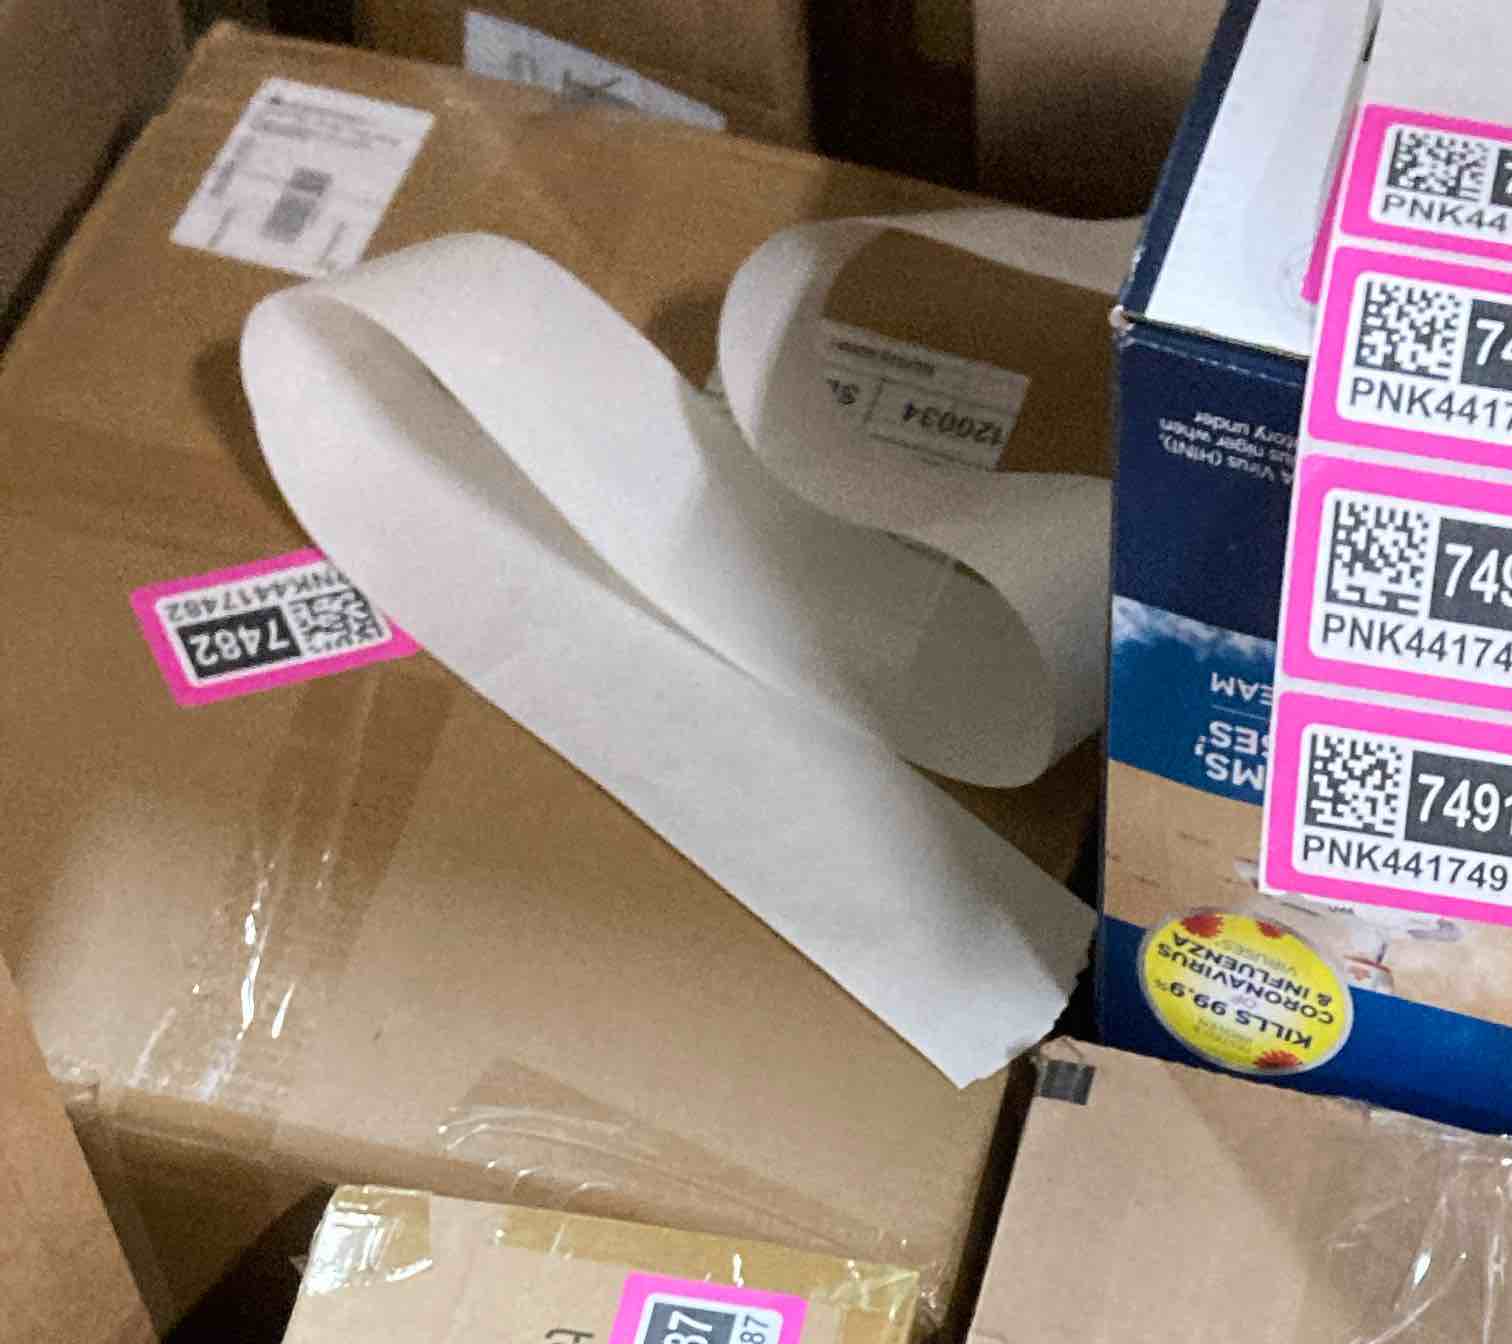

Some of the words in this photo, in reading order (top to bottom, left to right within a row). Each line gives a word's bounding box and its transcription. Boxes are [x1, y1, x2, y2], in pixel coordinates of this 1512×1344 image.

[1159, 417, 1212, 443] when
[1195, 411, 1250, 436] under
[1216, 436, 1265, 458] niger
[1226, 456, 1276, 482] Virus
[189, 618, 291, 667] 7482
[1171, 931, 1312, 1000] INFLUENZA
[1154, 978, 1228, 1016] 99.9%
[1156, 941, 1335, 1026] CORONAVIRUS
[1316, 991, 1333, 1006] &
[1234, 1009, 1313, 1049] KILLS
